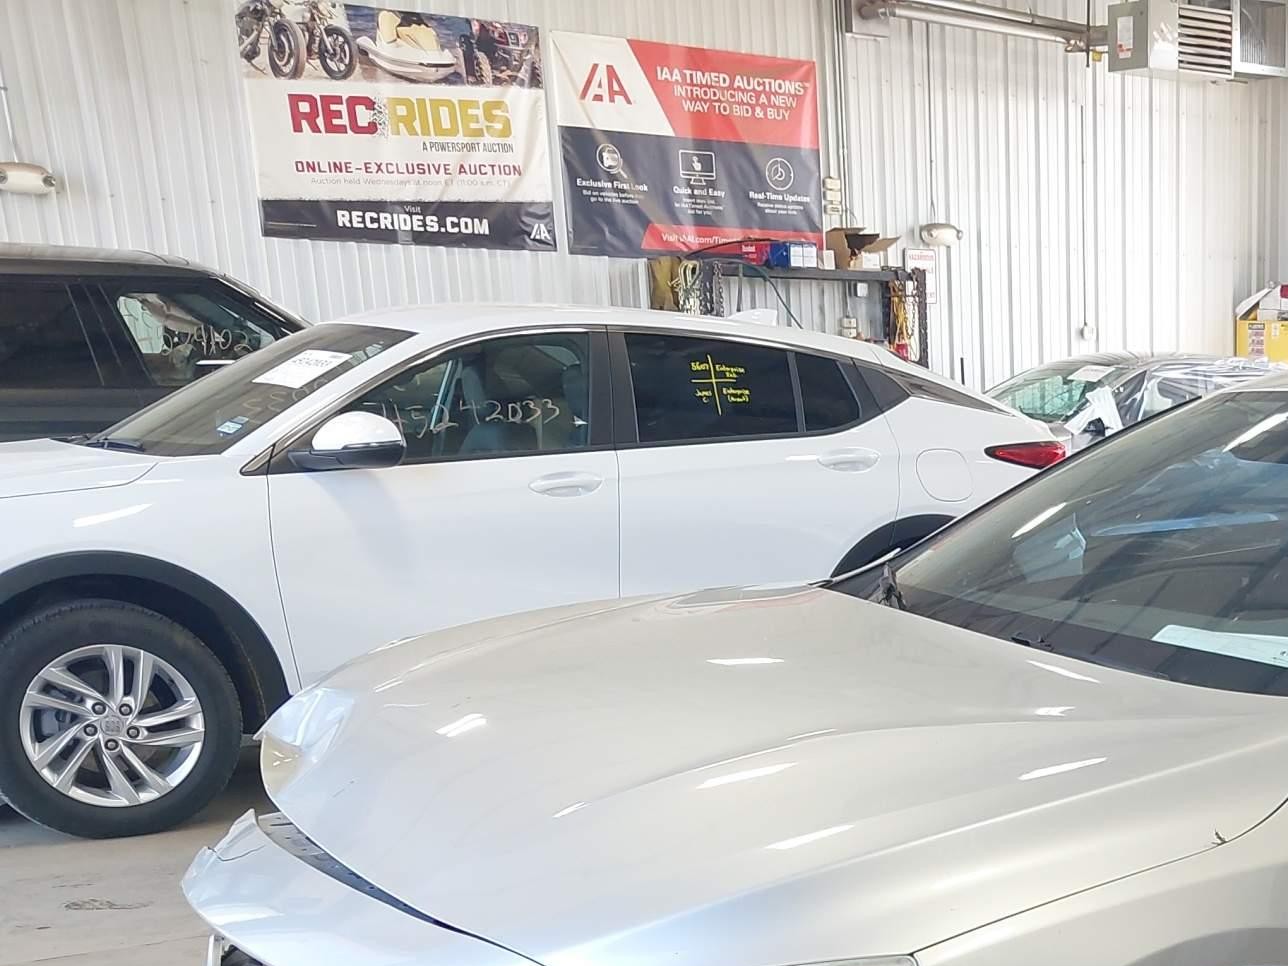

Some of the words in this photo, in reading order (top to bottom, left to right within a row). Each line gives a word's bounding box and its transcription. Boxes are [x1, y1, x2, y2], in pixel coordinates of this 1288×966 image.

[656, 66, 682, 82] IAA
[682, 69, 730, 88] TIMED
[674, 85, 756, 104] INTRODUCING
[759, 94, 768, 105] A
[770, 95, 797, 108] NEW
[682, 99, 711, 113] WAY
[712, 102, 730, 115] TO
[733, 104, 752, 117] BID
[754, 106, 764, 118] &
[767, 108, 790, 120] BUY
[387, 97, 513, 138] RIDES
[422, 142, 428, 152] A
[429, 142, 481, 153] POWERSPORT
[482, 143, 514, 153] AUCTION
[295, 160, 452, 176] ONLINE-EXCLUSIVE
[458, 163, 522, 176] AUCTION
[576, 178, 612, 188] Exclusive
[613, 180, 631, 190] First
[672, 185, 692, 195] Quick
[693, 187, 707, 196] and
[708, 187, 725, 198] Easy
[784, 193, 811, 203] Updates
[404, 205, 421, 213] Visit
[336, 210, 490, 235] RECRIDES.COM
[661, 233, 678, 242] Visit
